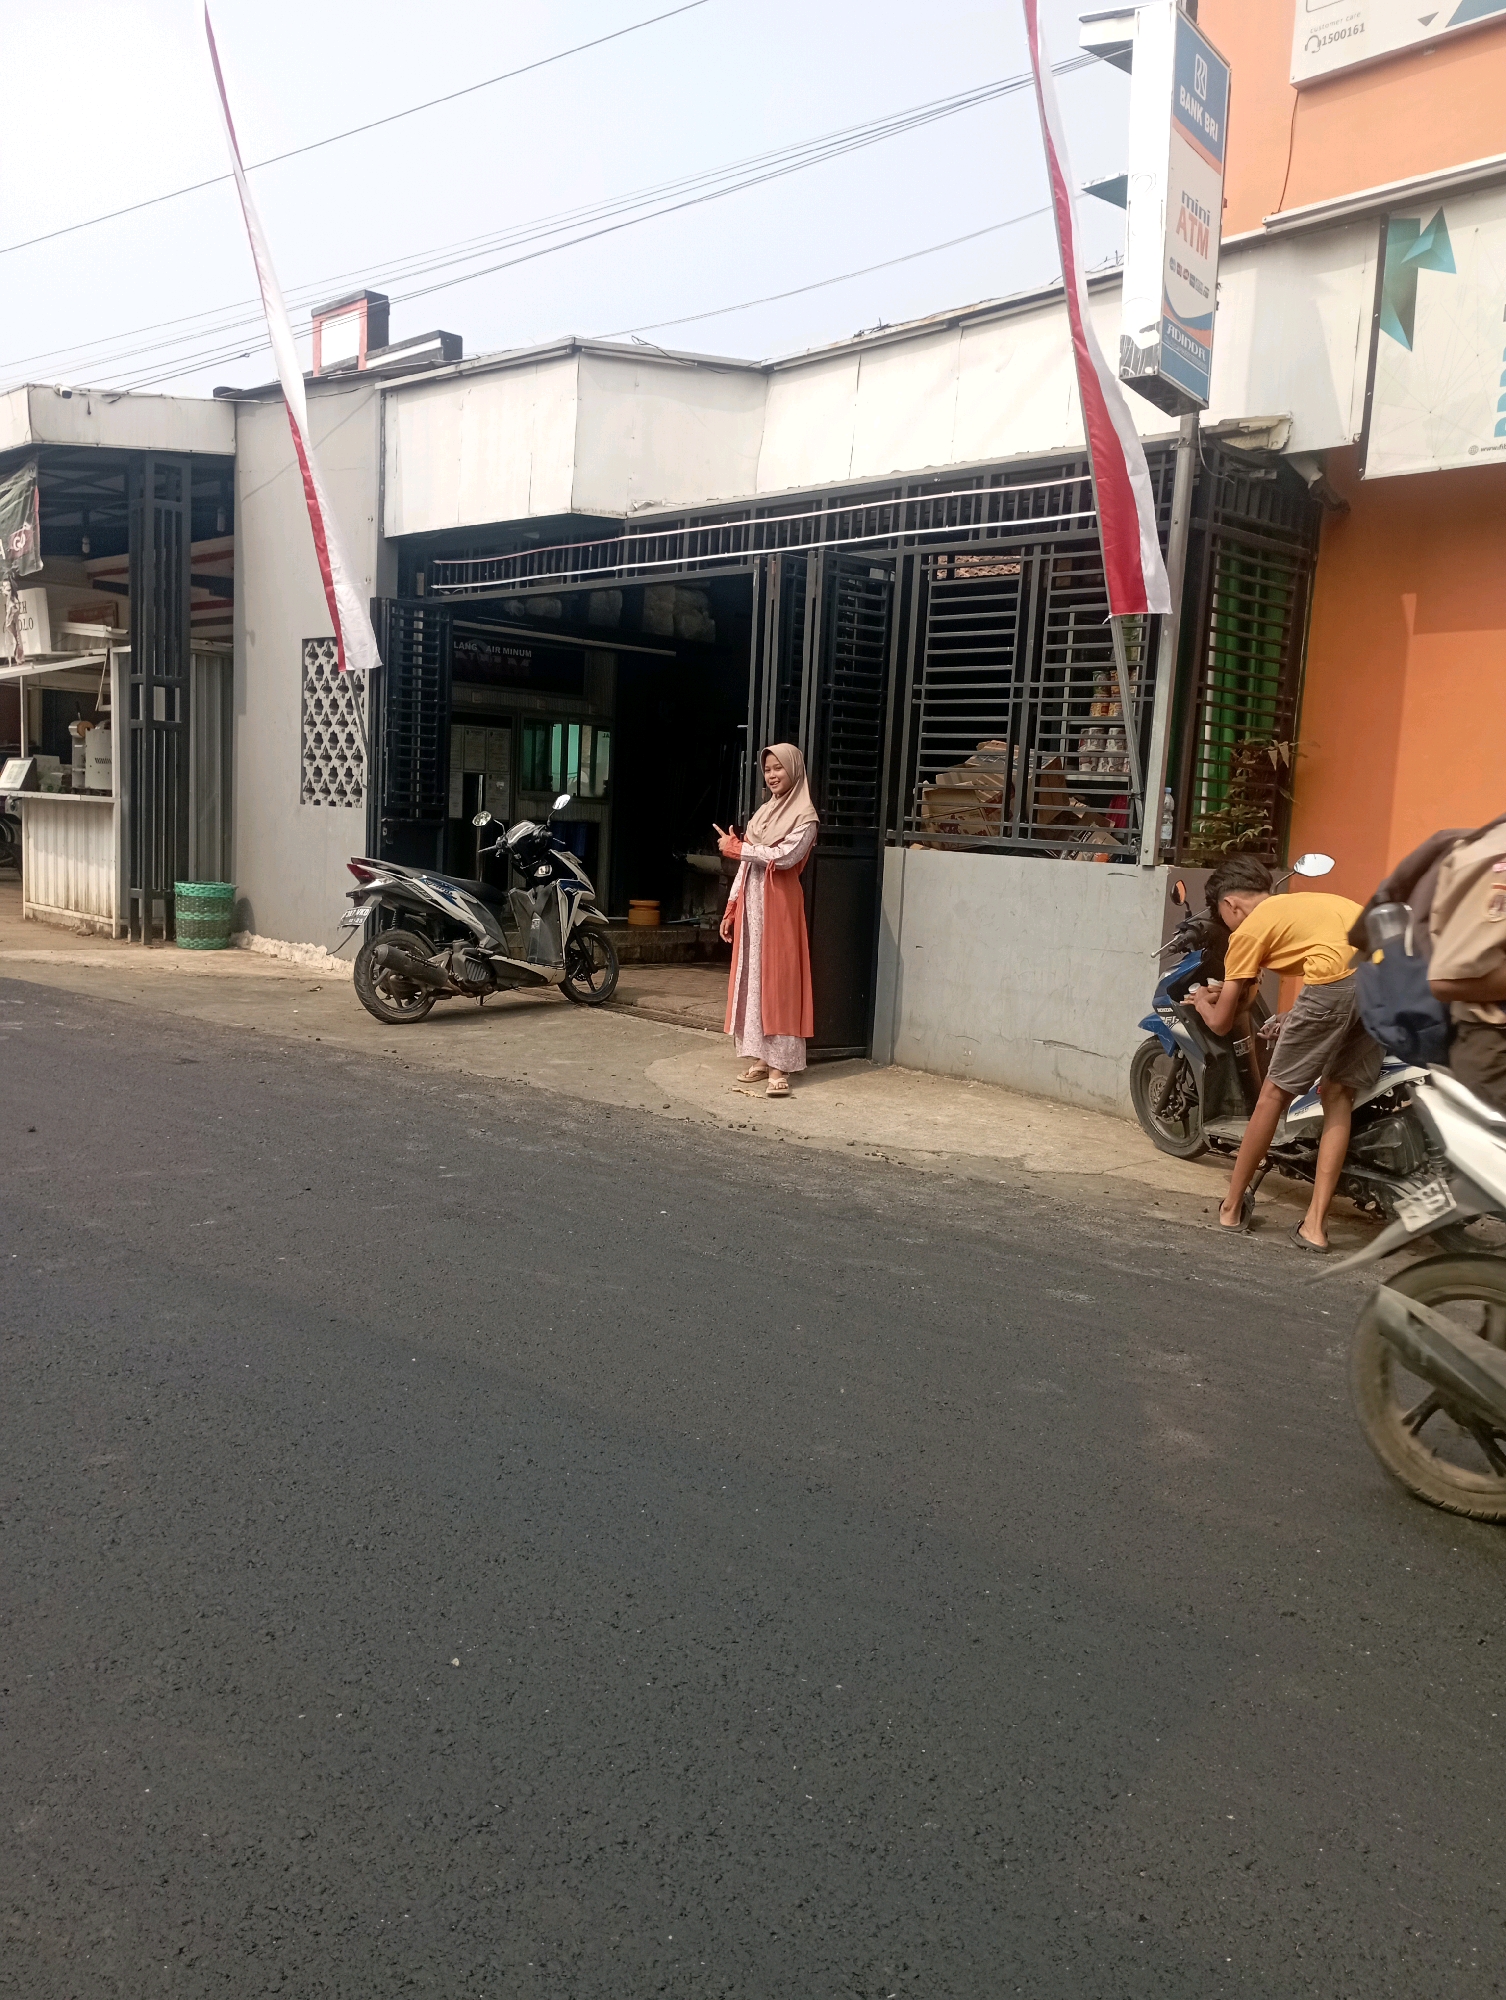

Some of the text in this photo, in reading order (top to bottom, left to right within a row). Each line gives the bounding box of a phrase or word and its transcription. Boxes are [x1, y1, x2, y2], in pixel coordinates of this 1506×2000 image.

[1310, 11, 1361, 34] customer care
[1321, 22, 1365, 47] 1500161
[1179, 84, 1219, 143] BANK BRI
[1181, 190, 1211, 228] mini
[1175, 204, 1210, 261] ATM
[453, 641, 532, 658] LANG AIR MINUM
